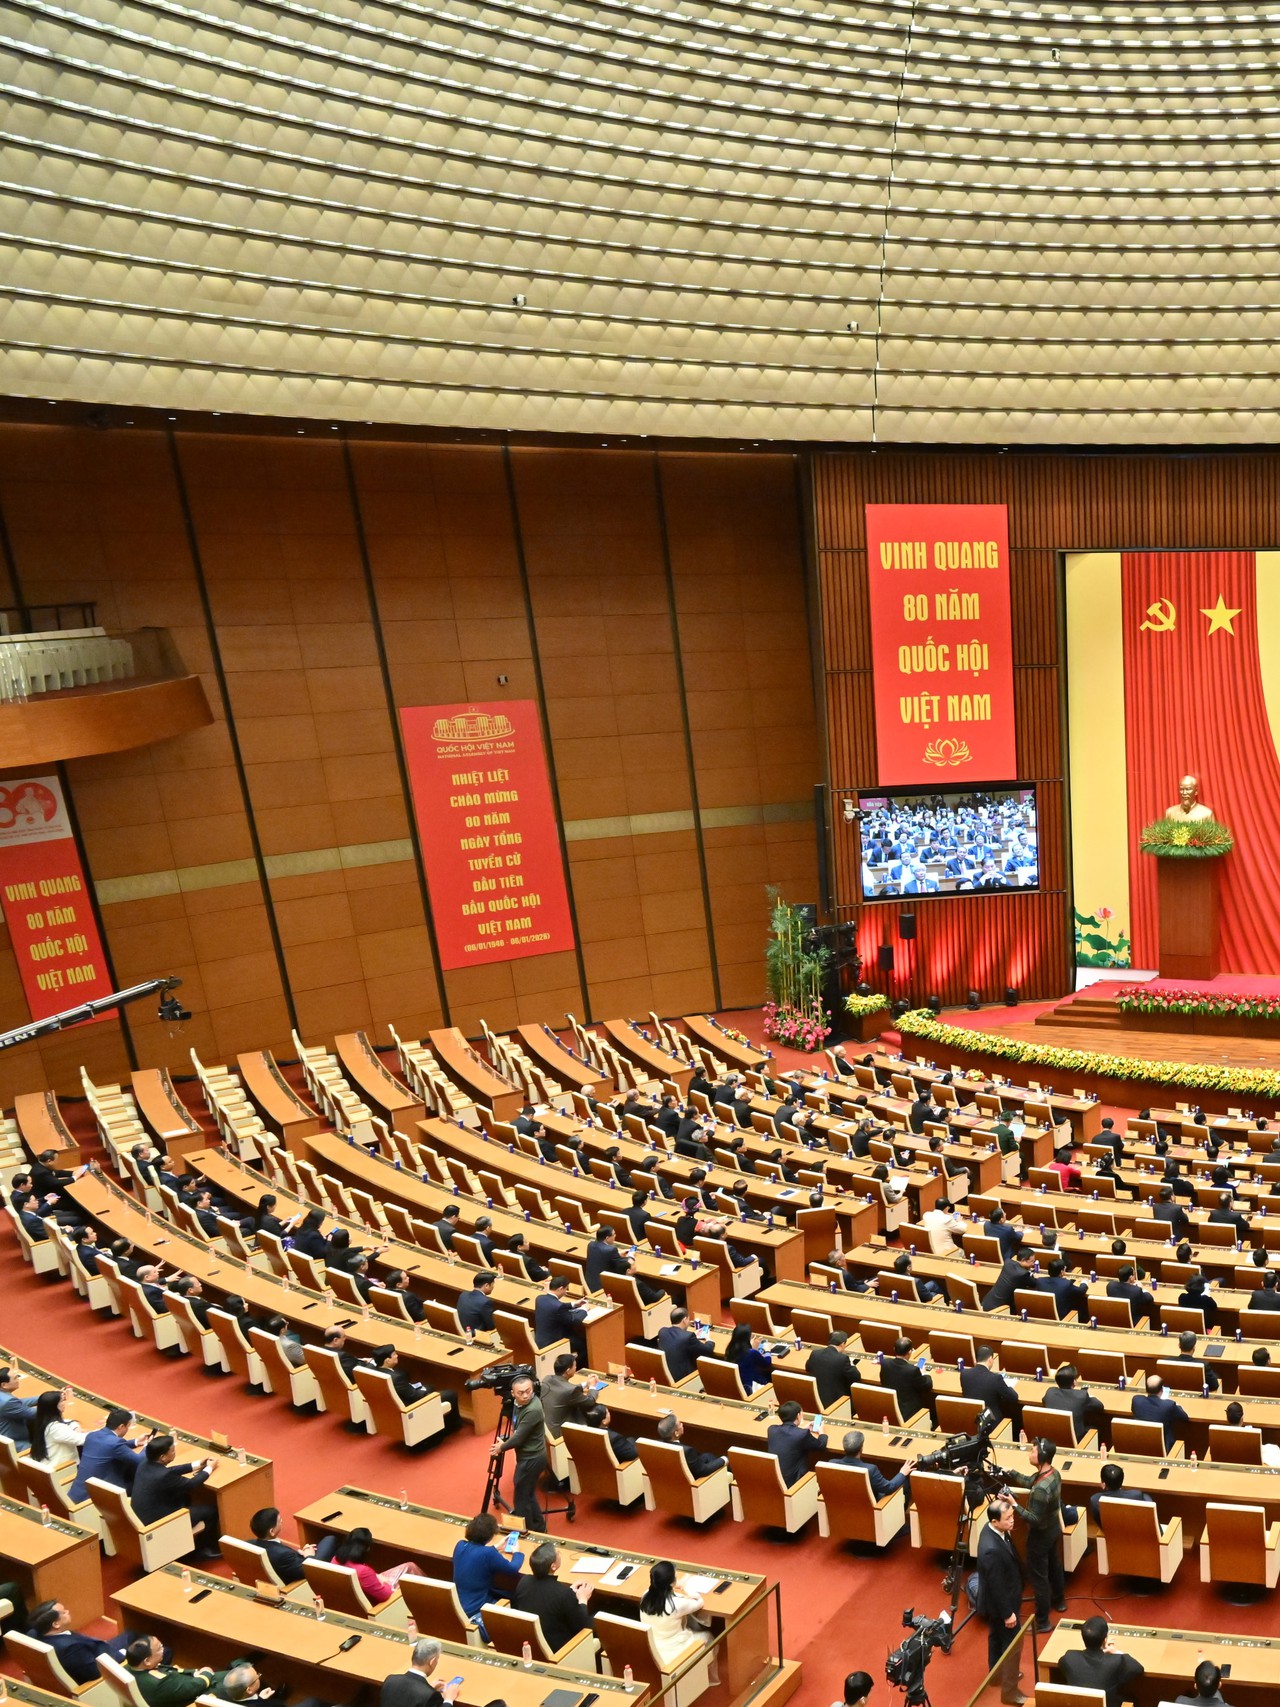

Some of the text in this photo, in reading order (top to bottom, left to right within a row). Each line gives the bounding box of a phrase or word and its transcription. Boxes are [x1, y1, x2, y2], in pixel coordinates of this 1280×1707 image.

[880, 541, 999, 570] VINH QUANG
[903, 588, 980, 621] 80 NĂM
[899, 636, 989, 676] QUỐC HỘI
[900, 692, 991, 729] VIỆT NAM
[452, 769, 509, 786] NHIỆT LIỆT
[450, 790, 518, 808] CHÀO MỪNG
[465, 812, 510, 828] 80 NĂM
[460, 830, 522, 850] NGÀY TỔNG
[468, 853, 521, 871] TUYỂN CỬ
[5, 875, 81, 902] VINH QUANG
[473, 875, 523, 892] ĐẦU TIÊN
[462, 893, 540, 915] BẦU QUỐC HỘI
[26, 905, 76, 929] 80 NĂM
[478, 917, 532, 936] VIỆT NAM
[30, 934, 88, 961] QUỐC HỘI
[37, 964, 96, 992] VIỆT NAM
